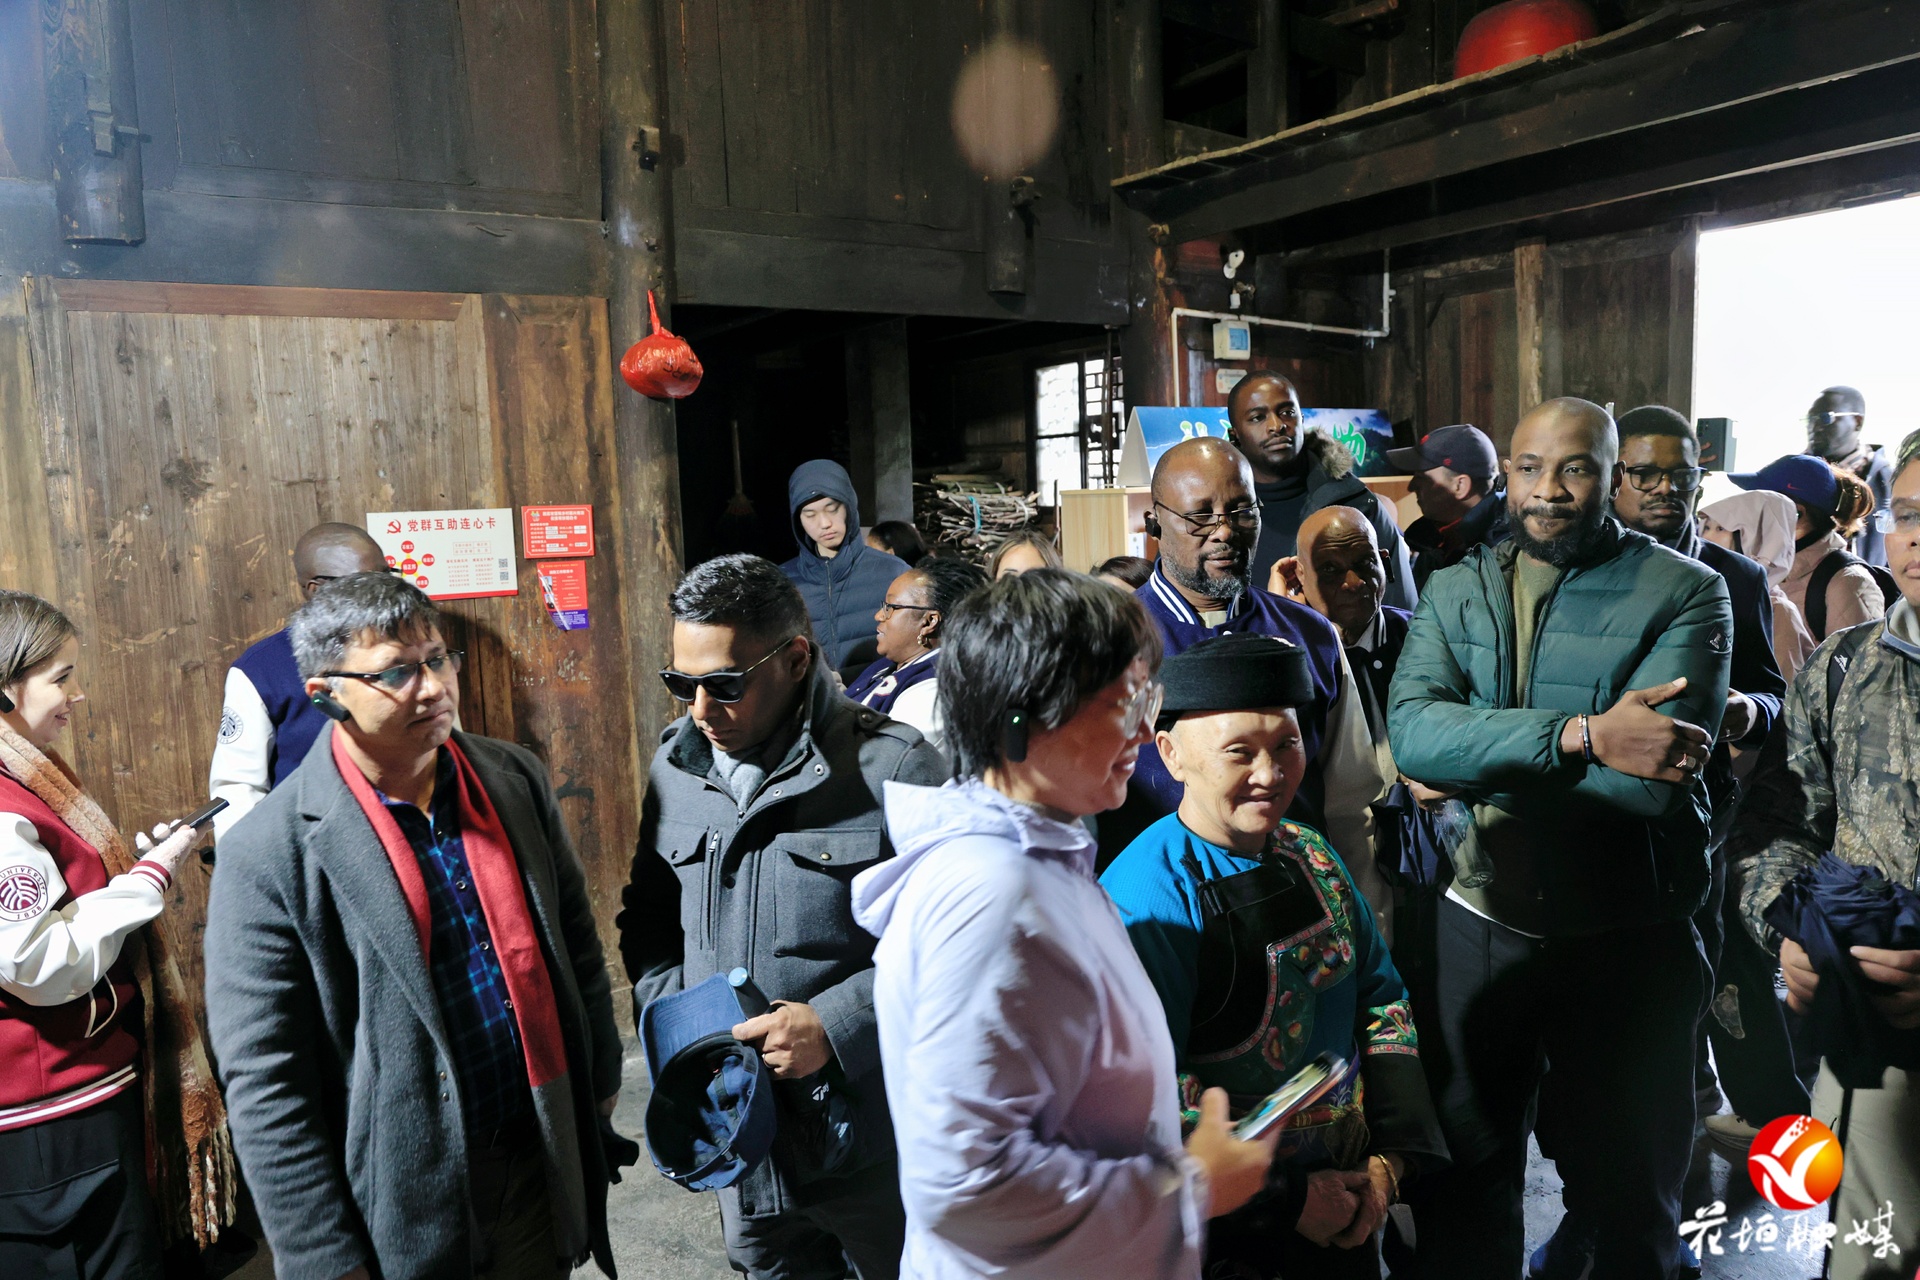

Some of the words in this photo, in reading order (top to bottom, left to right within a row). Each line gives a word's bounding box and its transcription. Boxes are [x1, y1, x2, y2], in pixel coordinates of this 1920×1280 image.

[407, 516, 496, 532] 党群互助连心卡
[17, 906, 42, 920] 1898
